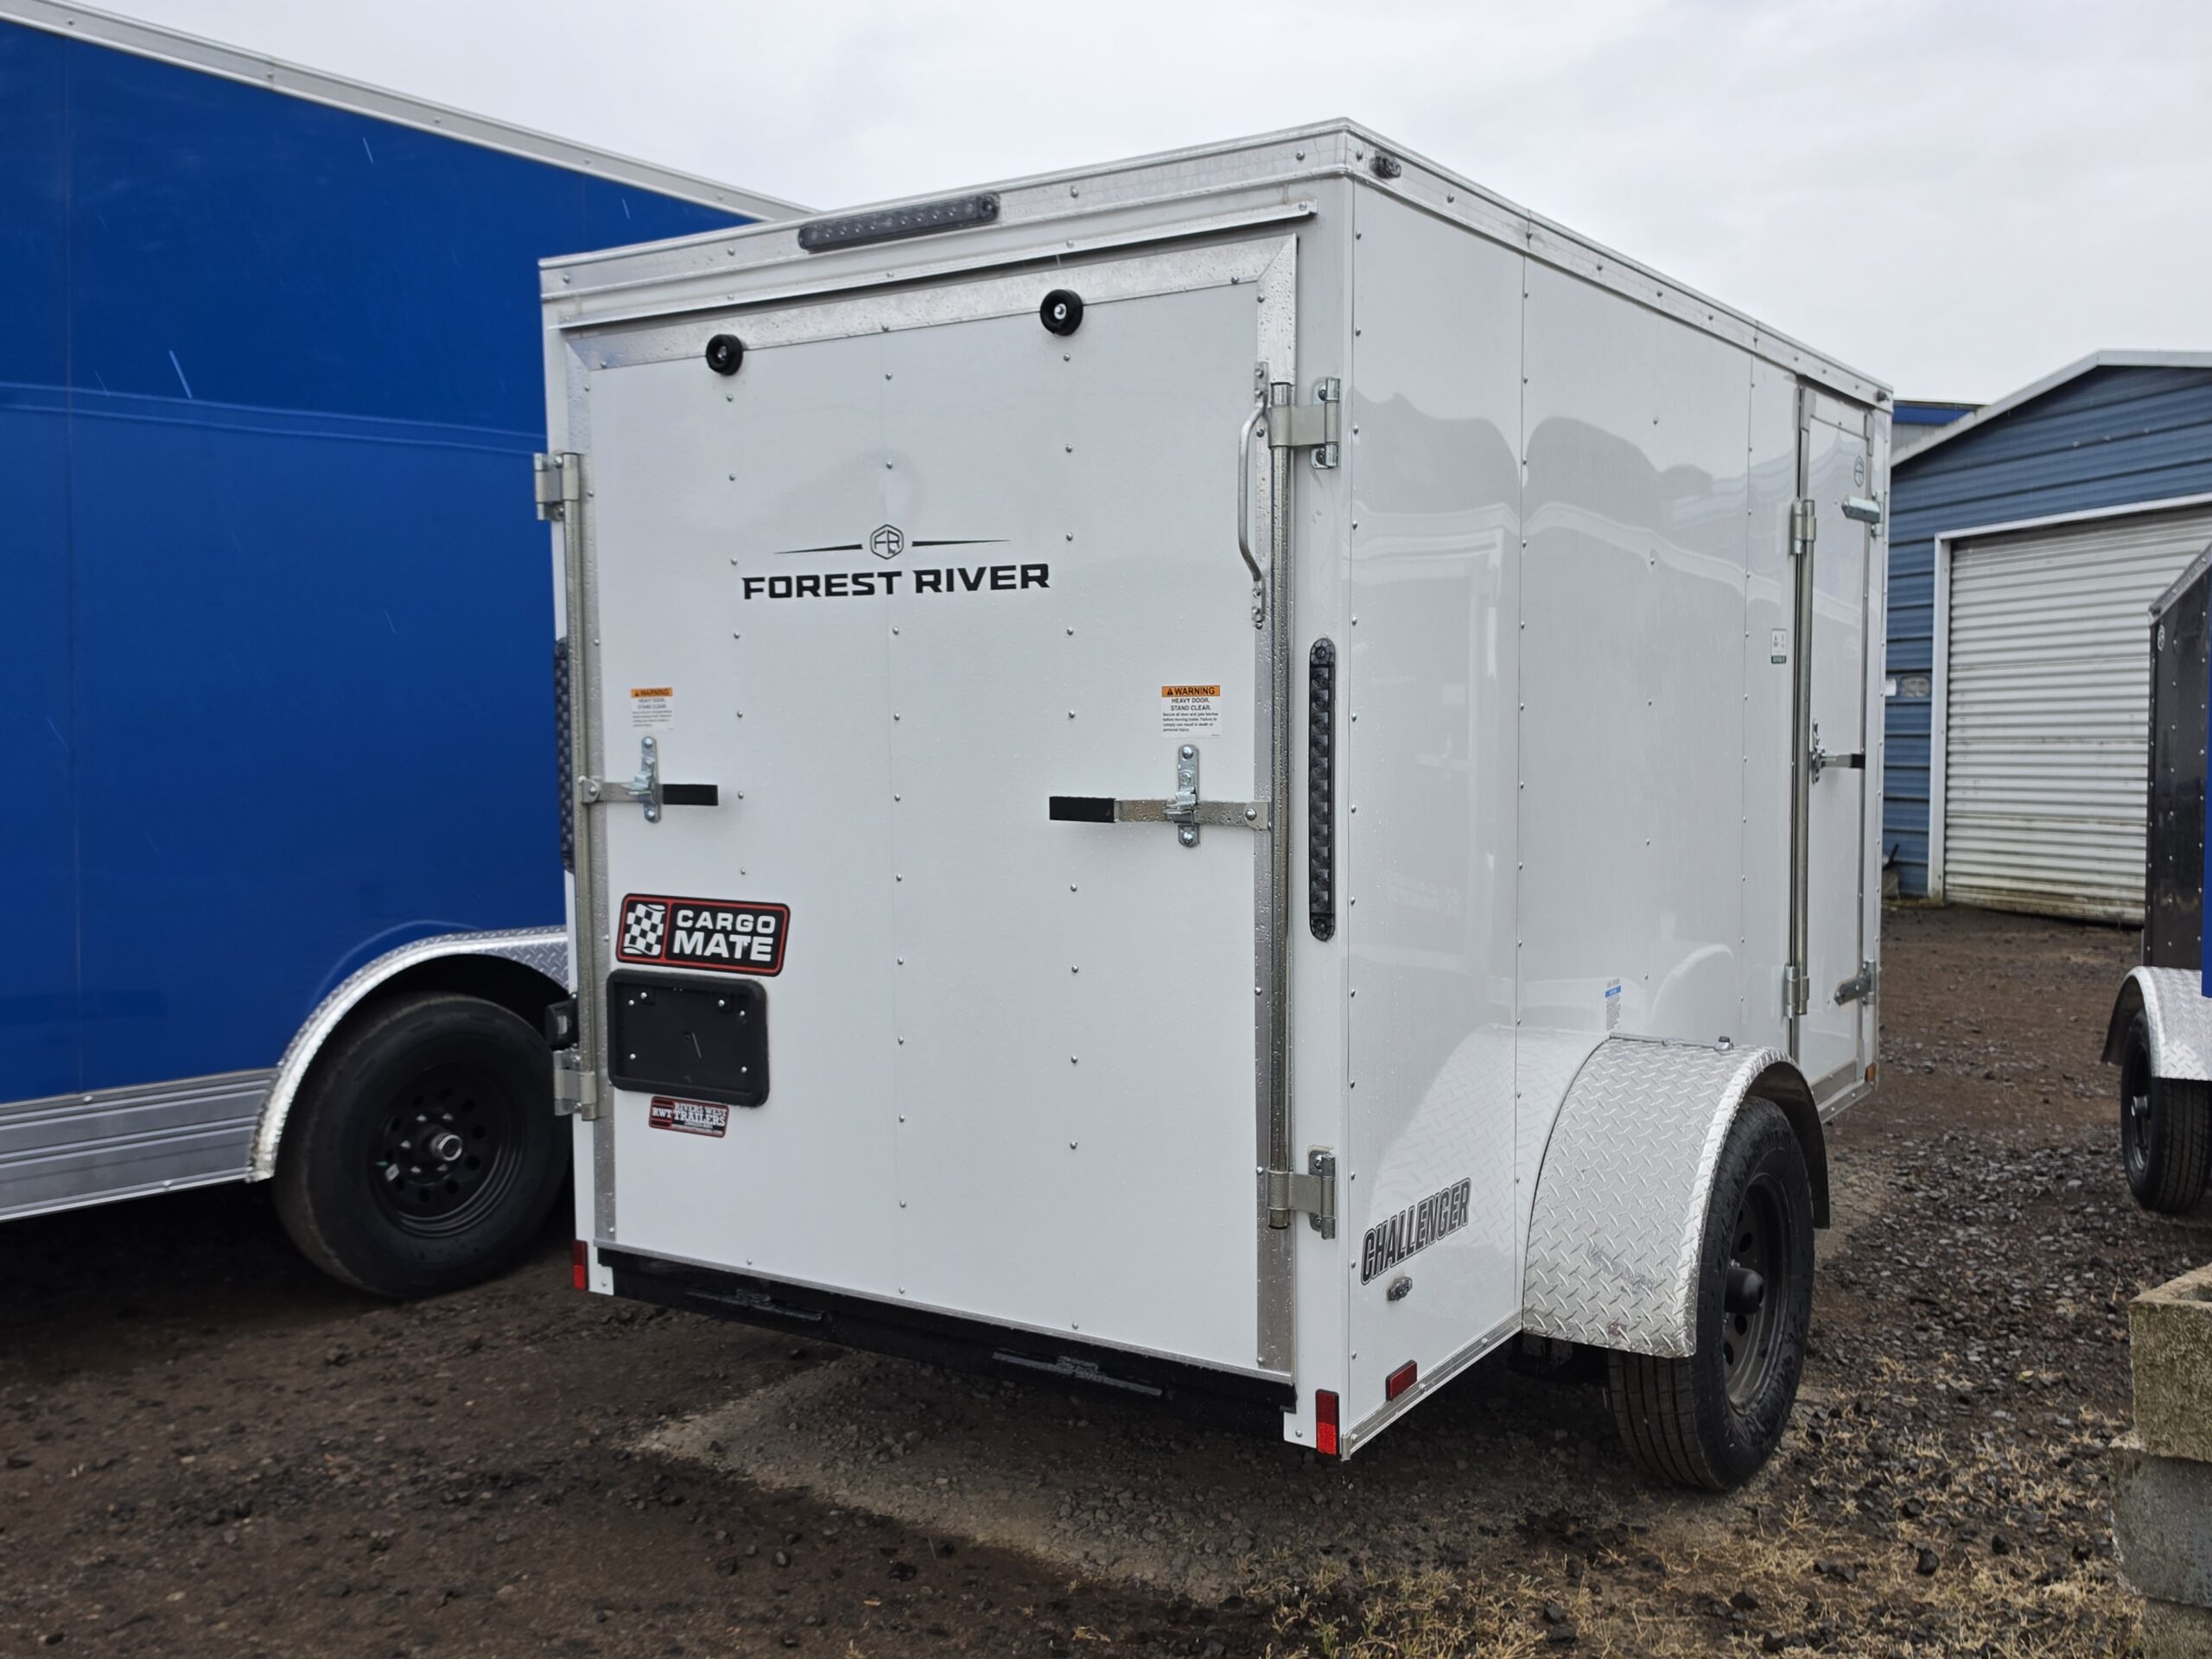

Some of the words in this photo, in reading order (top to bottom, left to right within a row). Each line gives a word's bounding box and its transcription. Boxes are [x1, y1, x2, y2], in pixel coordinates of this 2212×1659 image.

[741, 570, 903, 600] FOREST
[912, 563, 1051, 594] RIVER
[1174, 686, 1216, 696] WARNING
[677, 909, 776, 934] CARGO
[672, 930, 773, 962] MATE
[673, 1110, 726, 1127] TRAILERS
[674, 1103, 703, 1114] RIVERS
[704, 1106, 728, 1116] WEST
[1361, 1177, 1471, 1286] CHALLENGER
